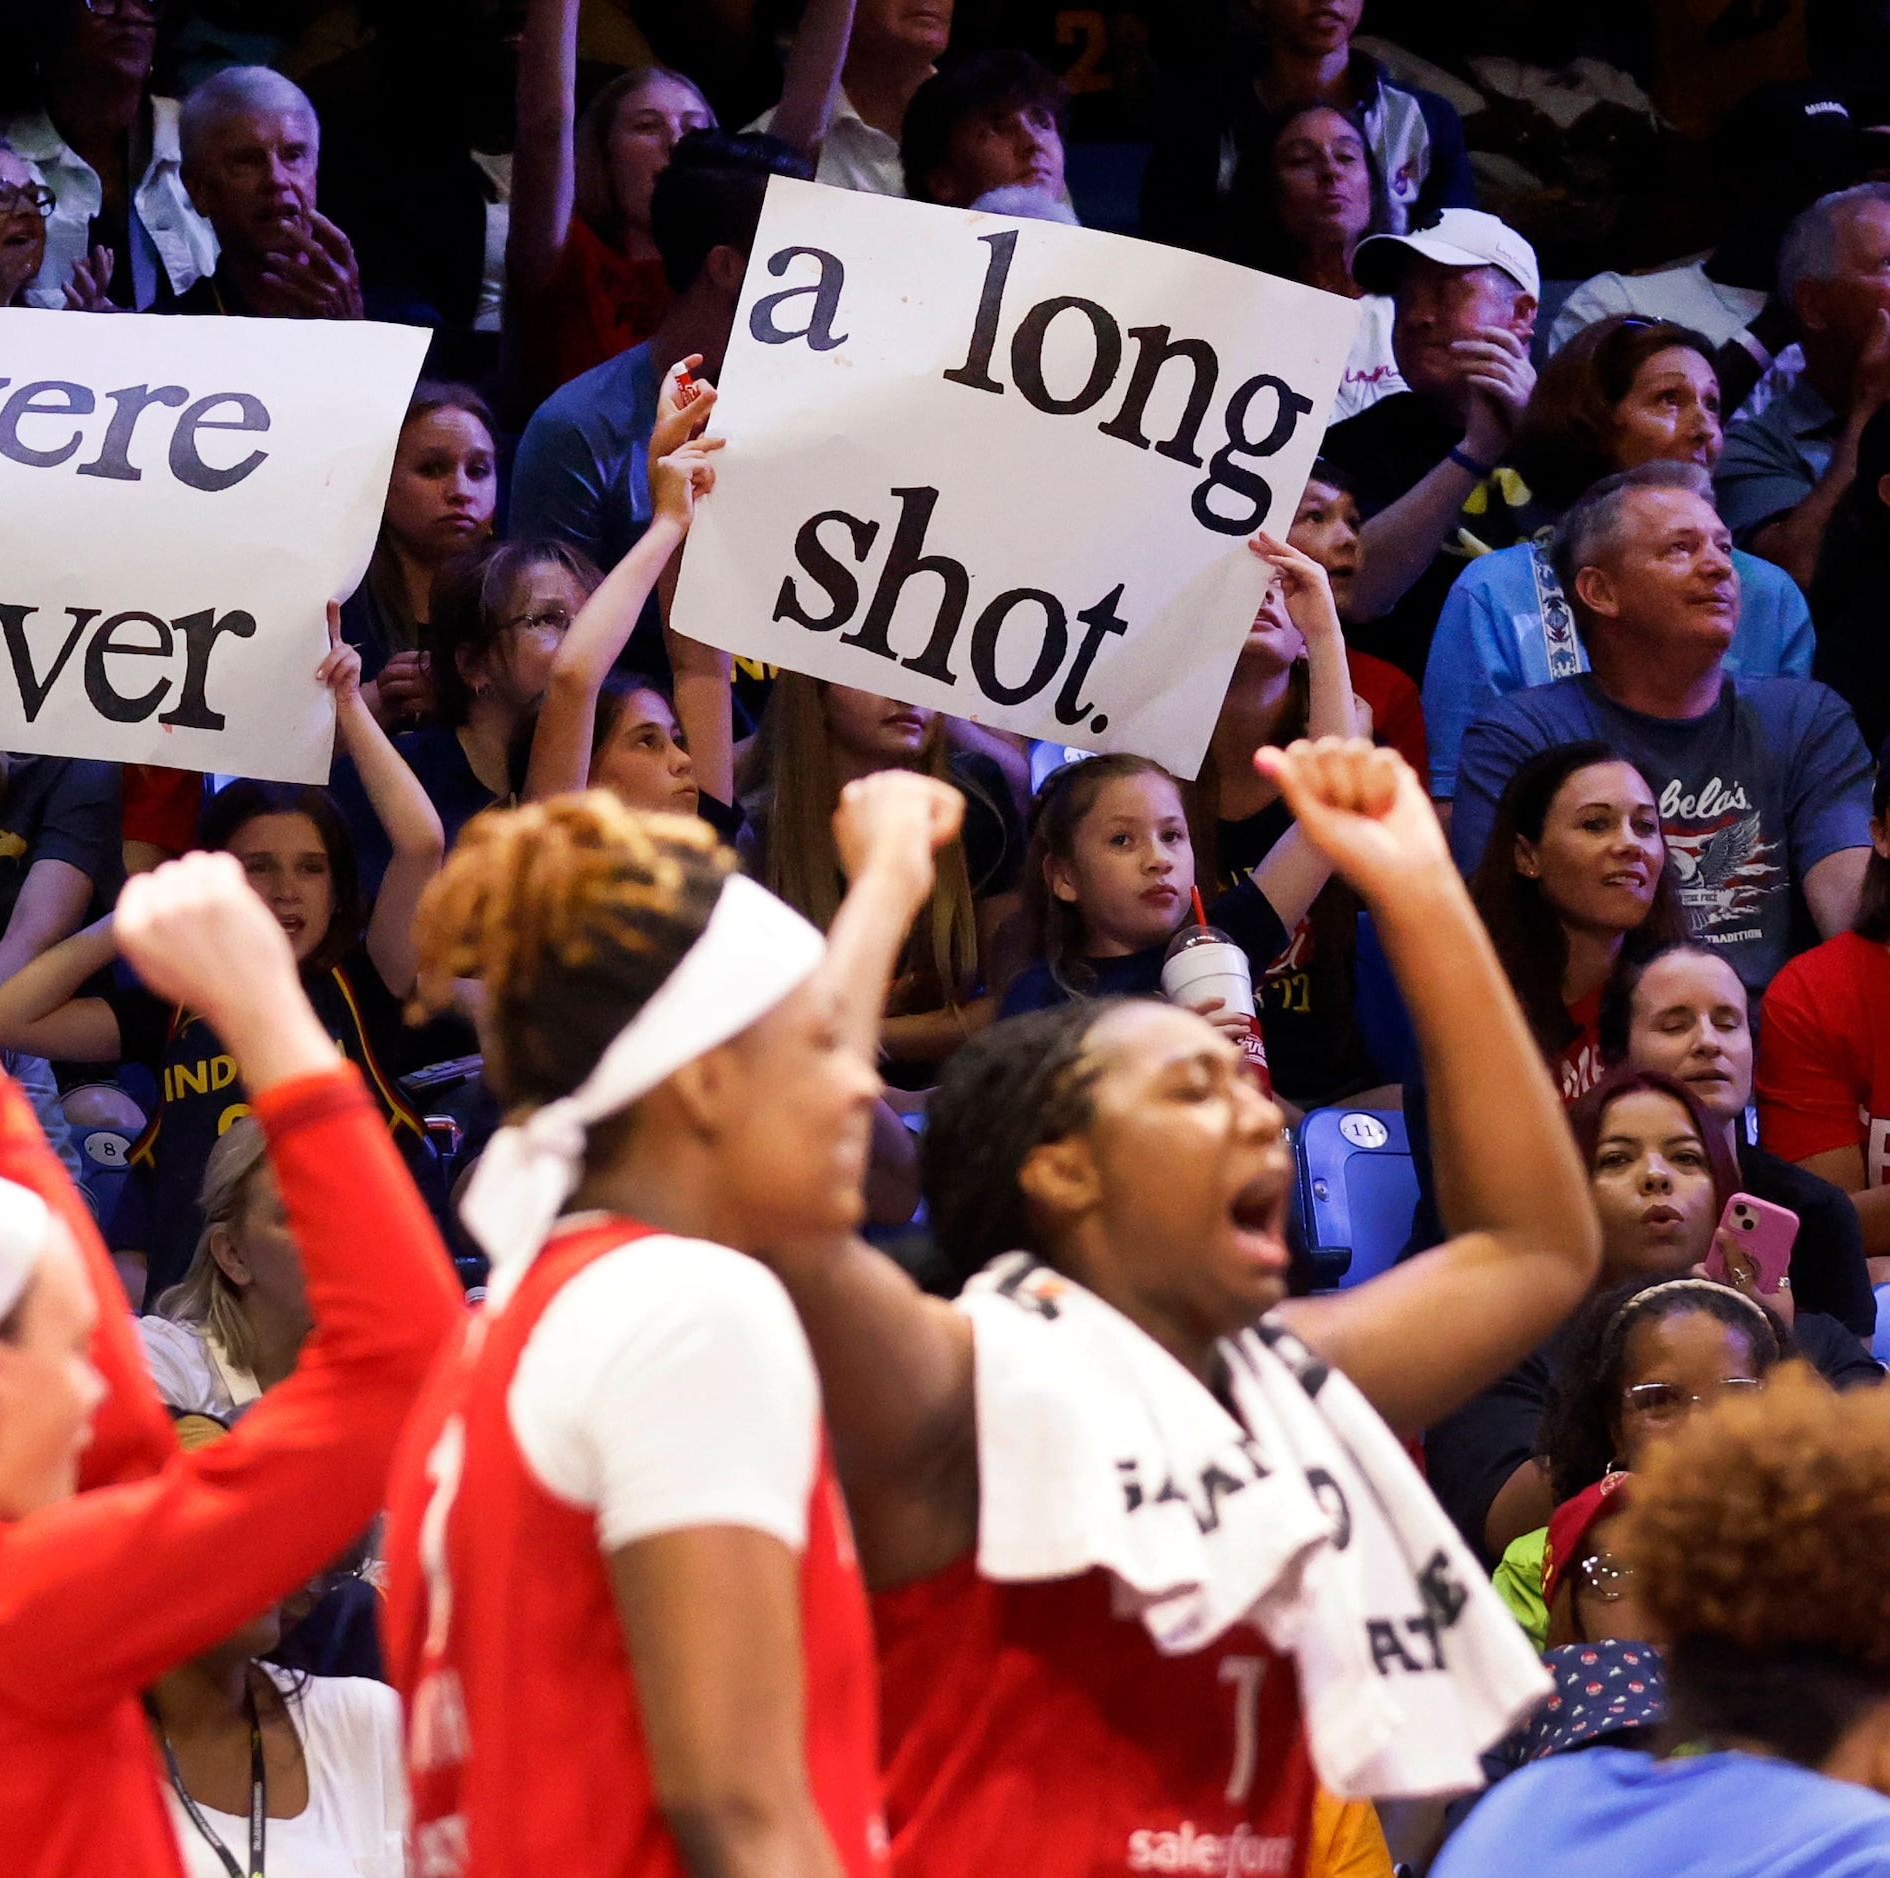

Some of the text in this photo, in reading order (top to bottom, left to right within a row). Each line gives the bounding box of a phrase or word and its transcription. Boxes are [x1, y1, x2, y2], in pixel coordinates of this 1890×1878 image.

[750, 230, 1314, 536] a long
[772, 486, 1128, 735] shot.
[1704, 928, 1763, 945] TRADITION
[103, 1142, 117, 1156] 8
[1352, 1122, 1374, 1138] 11
[1216, 1654, 1270, 1806] 7
